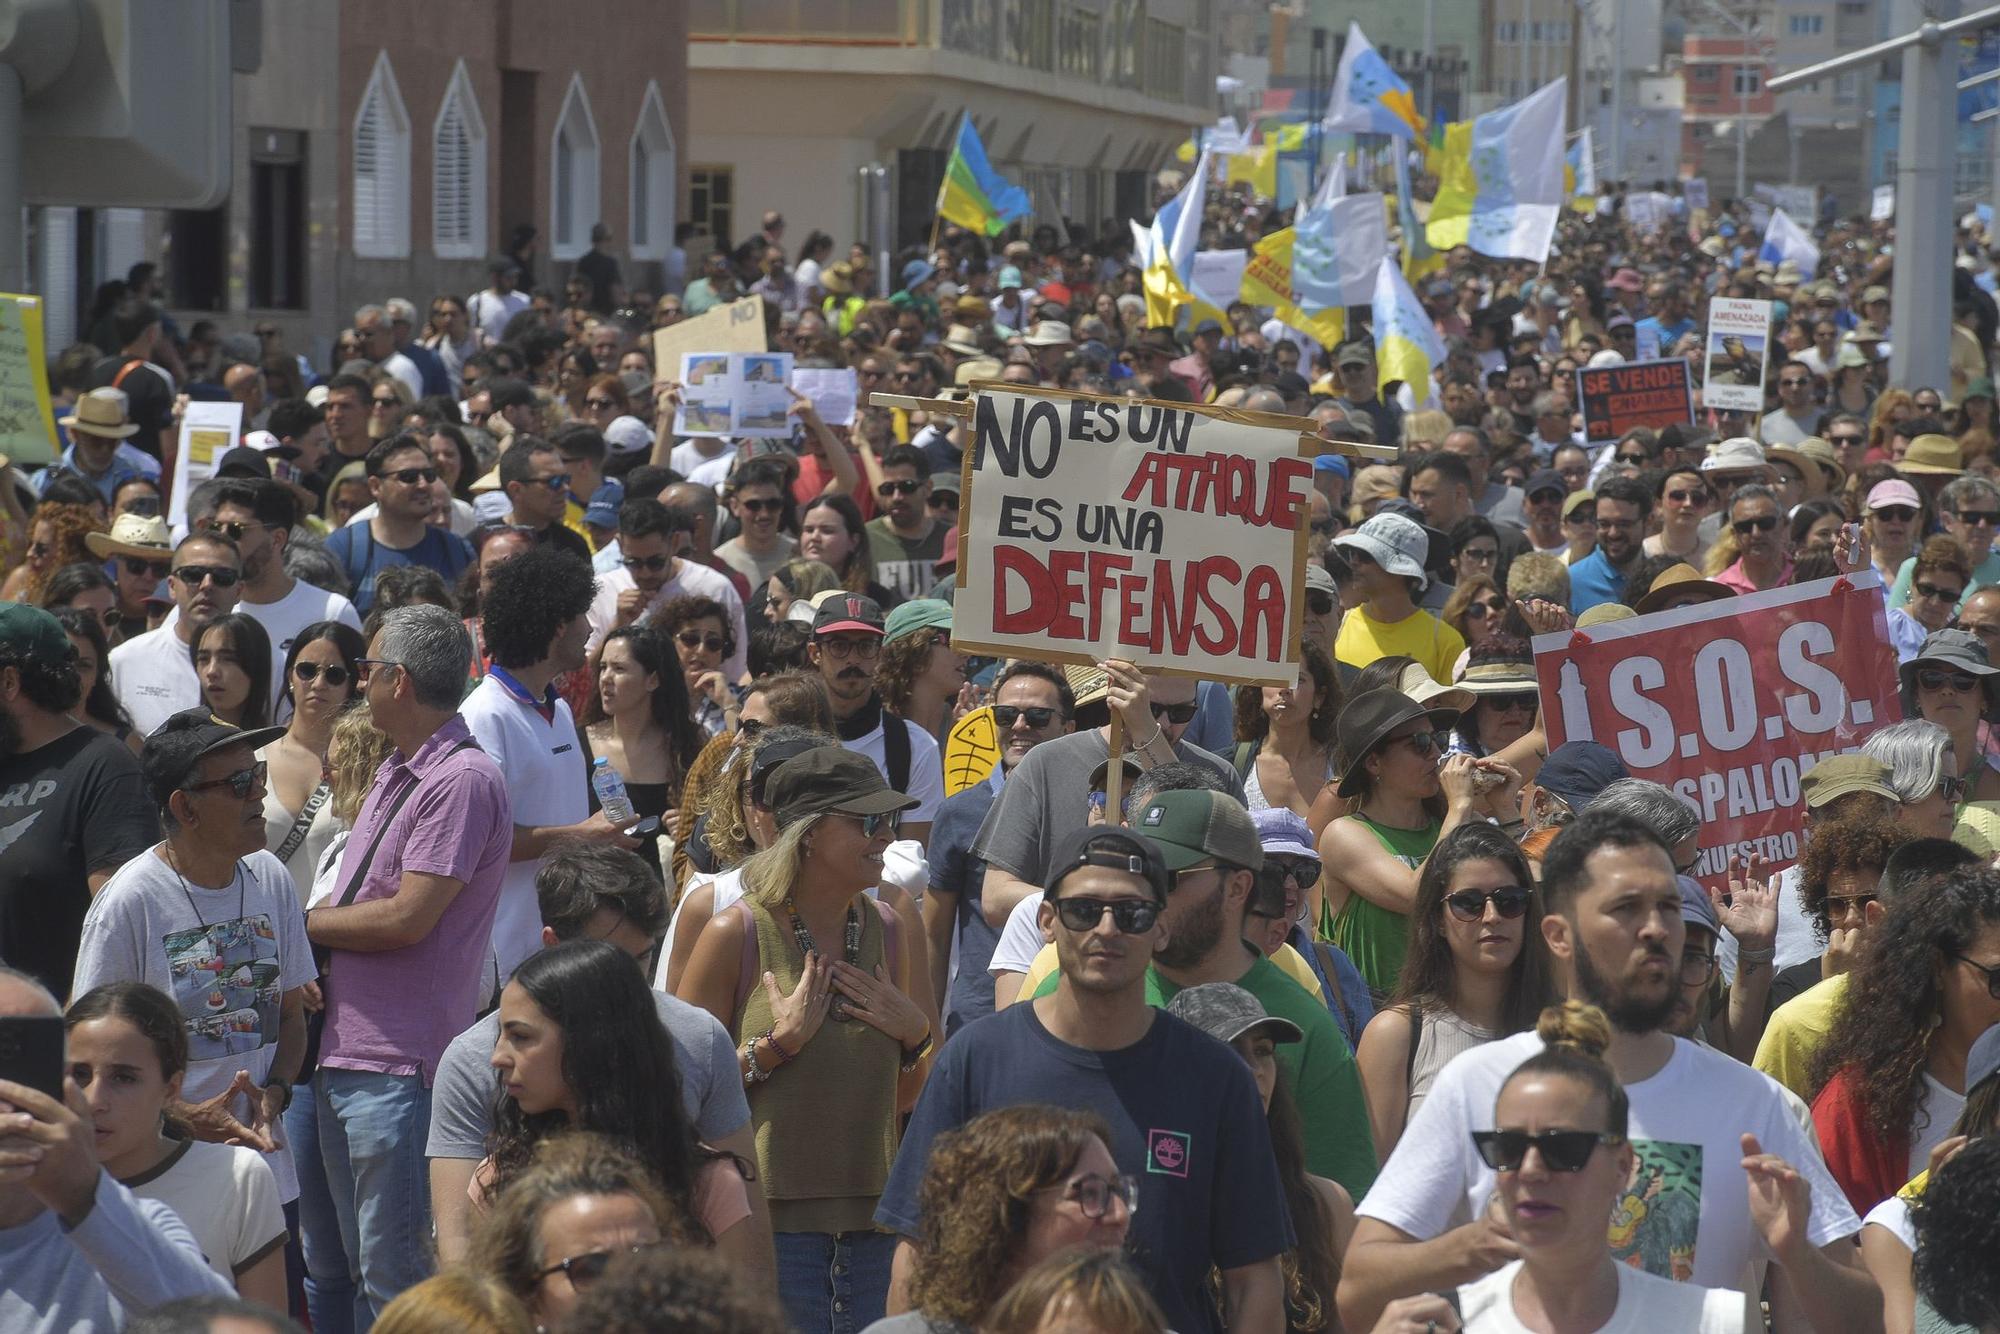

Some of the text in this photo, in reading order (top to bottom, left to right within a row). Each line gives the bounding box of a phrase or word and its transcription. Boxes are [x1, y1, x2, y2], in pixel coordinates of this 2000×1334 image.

[1714, 311, 1766, 323] AMENAZADA
[1728, 301, 1752, 310] FAUNA
[1584, 364, 1684, 396] SE VENDE
[972, 395, 1195, 479] NO ES UN
[1121, 451, 1313, 531] ATAQUE
[997, 495, 1164, 554] ES UNA
[992, 544, 1286, 662] DEFENSA
[1609, 621, 1874, 769] S.O.S.
[1697, 831, 1798, 877] NUESTRO
